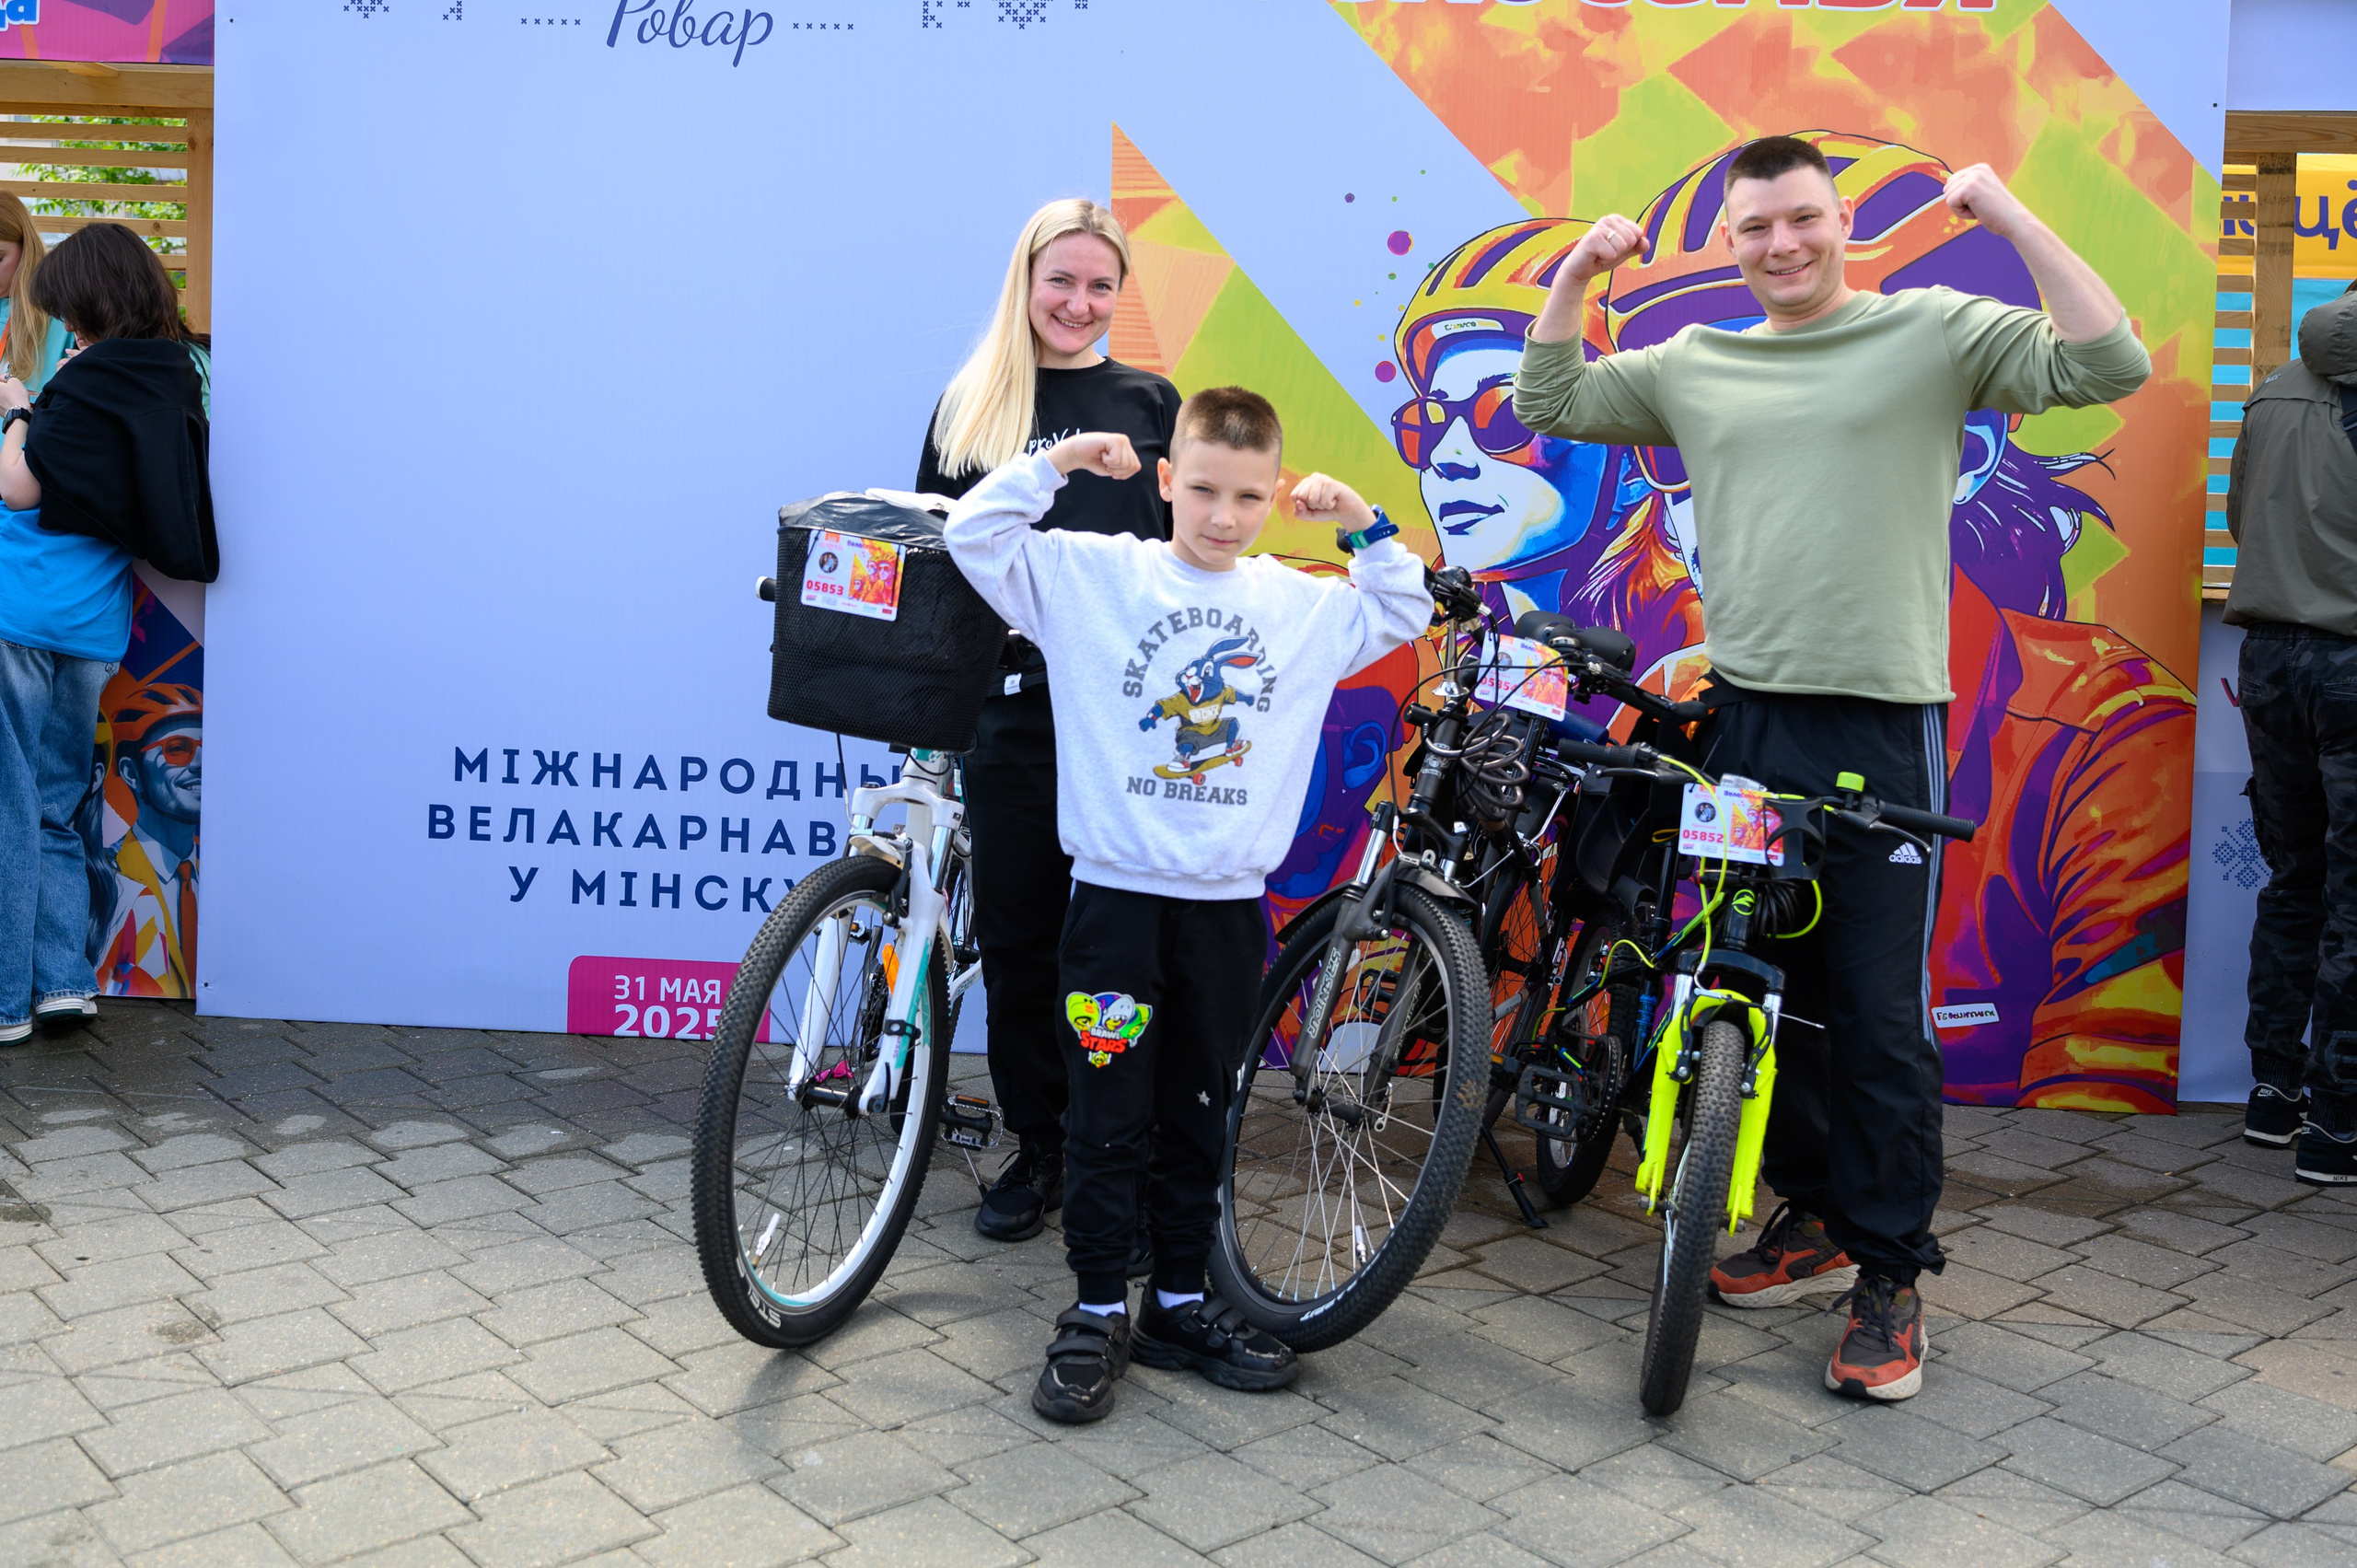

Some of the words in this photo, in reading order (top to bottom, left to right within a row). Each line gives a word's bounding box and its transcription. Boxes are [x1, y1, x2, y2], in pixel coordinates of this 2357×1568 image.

[806, 579, 844, 597] 05853
[1122, 607, 1277, 713] SKATEBOARDING
[454, 746, 900, 802] МІЖНАРОДНЫ
[1126, 776, 1156, 796] NO
[1164, 782, 1248, 806] BREAKS
[427, 804, 837, 857] ВЕЛАКАРНАВ
[1682, 829, 1724, 843] 05852
[1888, 854, 1922, 865] adidas
[509, 865, 540, 903] У
[571, 868, 795, 914] МІНСК
[614, 974, 645, 1001] 31
[659, 977, 721, 1005] МАЯ
[1080, 1030, 1128, 1053] STARS
[2258, 1087, 2273, 1096] NIKE
